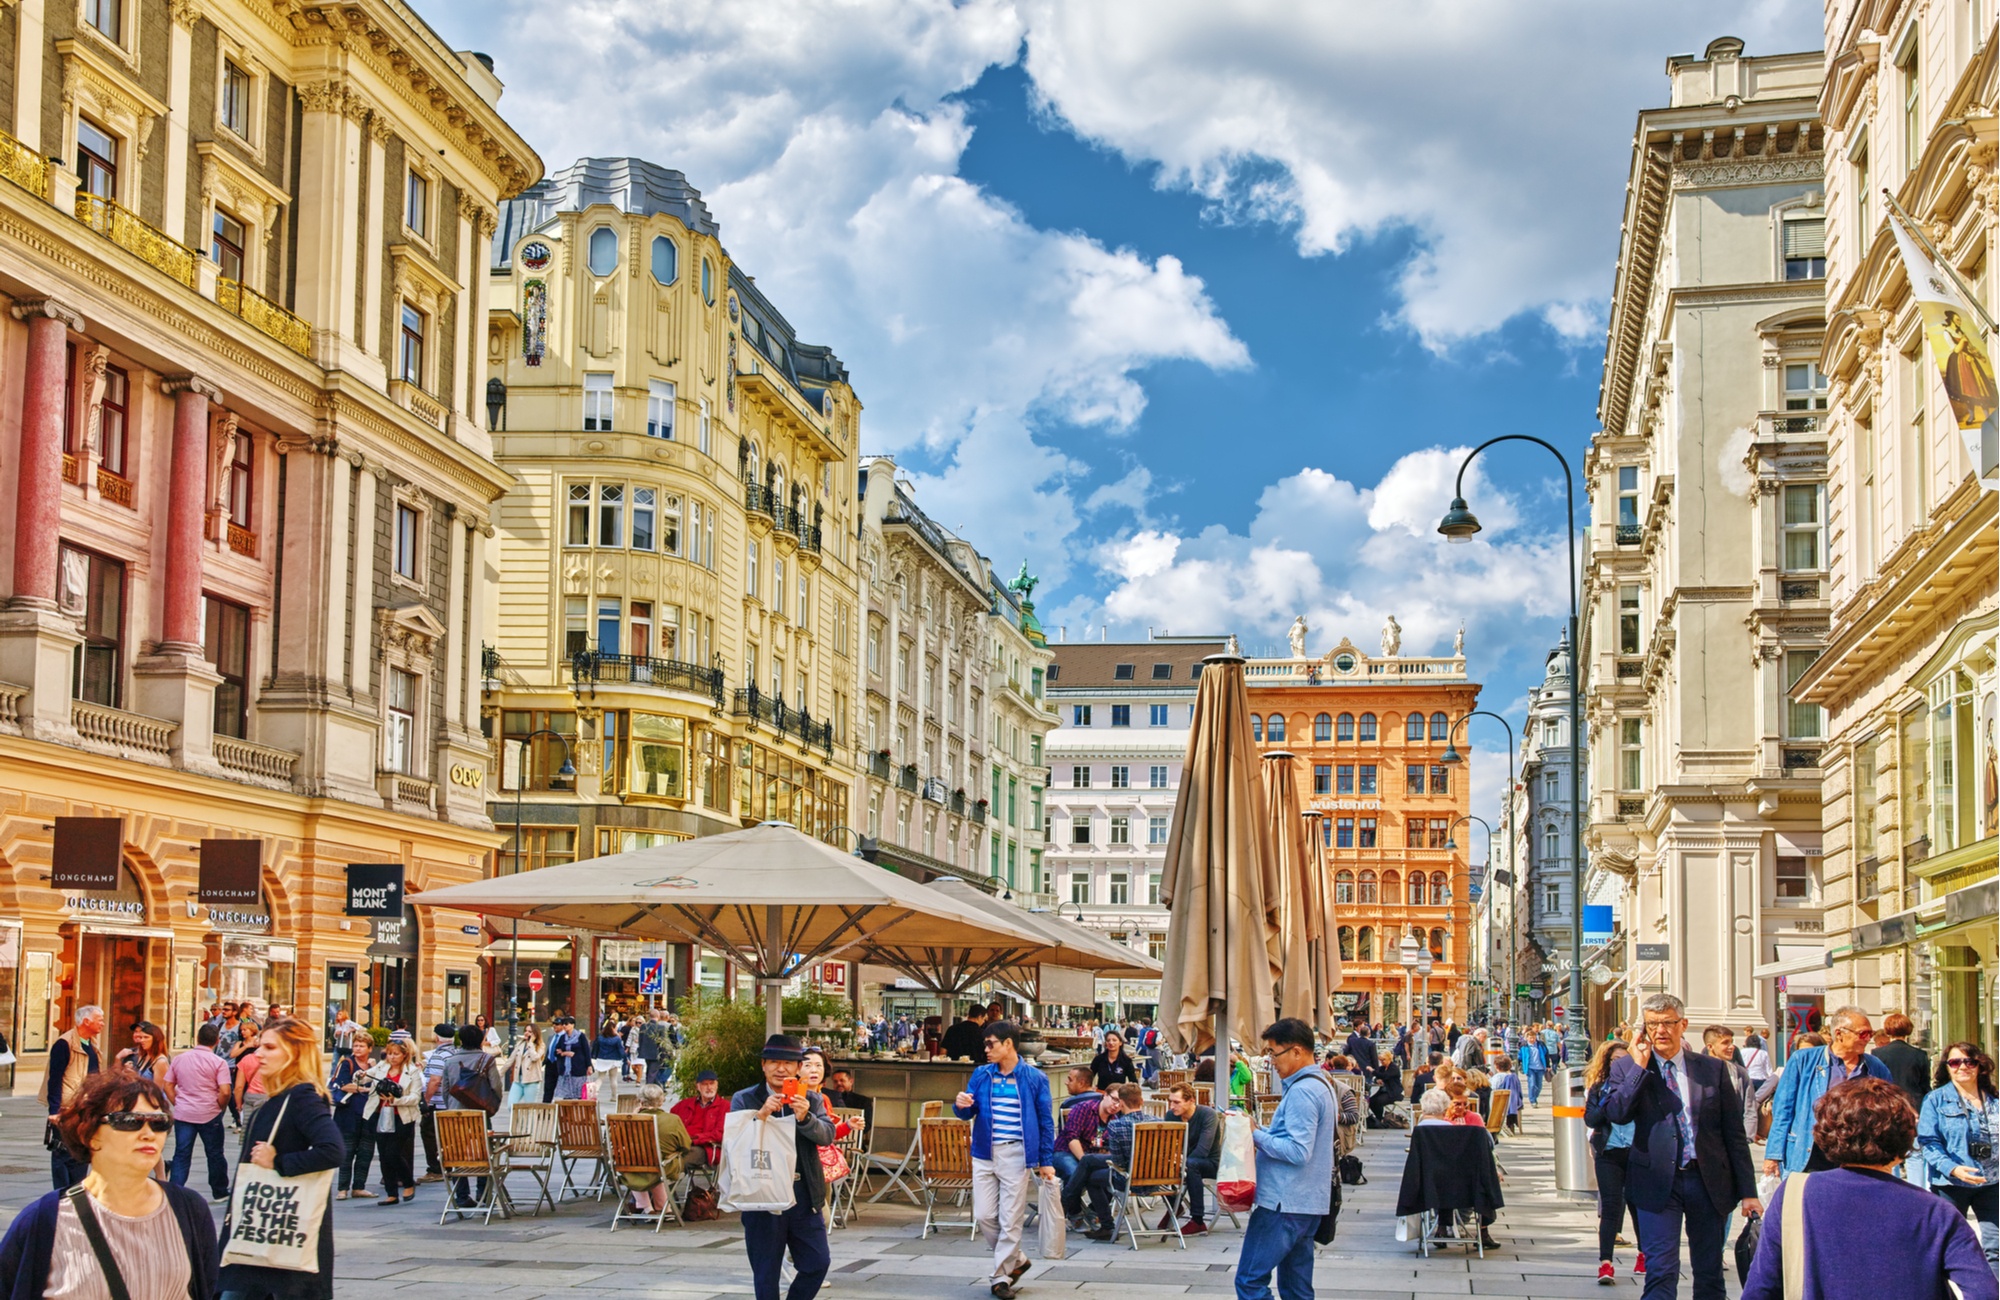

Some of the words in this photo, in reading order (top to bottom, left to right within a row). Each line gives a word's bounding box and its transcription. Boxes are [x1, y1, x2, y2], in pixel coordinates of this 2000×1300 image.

[1310, 797, 1383, 810] wüstenrot
[54, 873, 115, 882] LONGCHAMP
[352, 888, 387, 898] MONT
[69, 896, 143, 913] ONGCHAMP
[352, 899, 387, 909] BLANC
[210, 910, 270, 925] ONGCHAMP
[377, 921, 401, 932] MONT
[377, 932, 401, 945] BLANC
[1585, 937, 1606, 945] ERSTE
[245, 1181, 299, 1200] HOW
[242, 1195, 300, 1215] MUCH
[260, 1213, 299, 1231] THE
[233, 1225, 307, 1248] FESCH?
